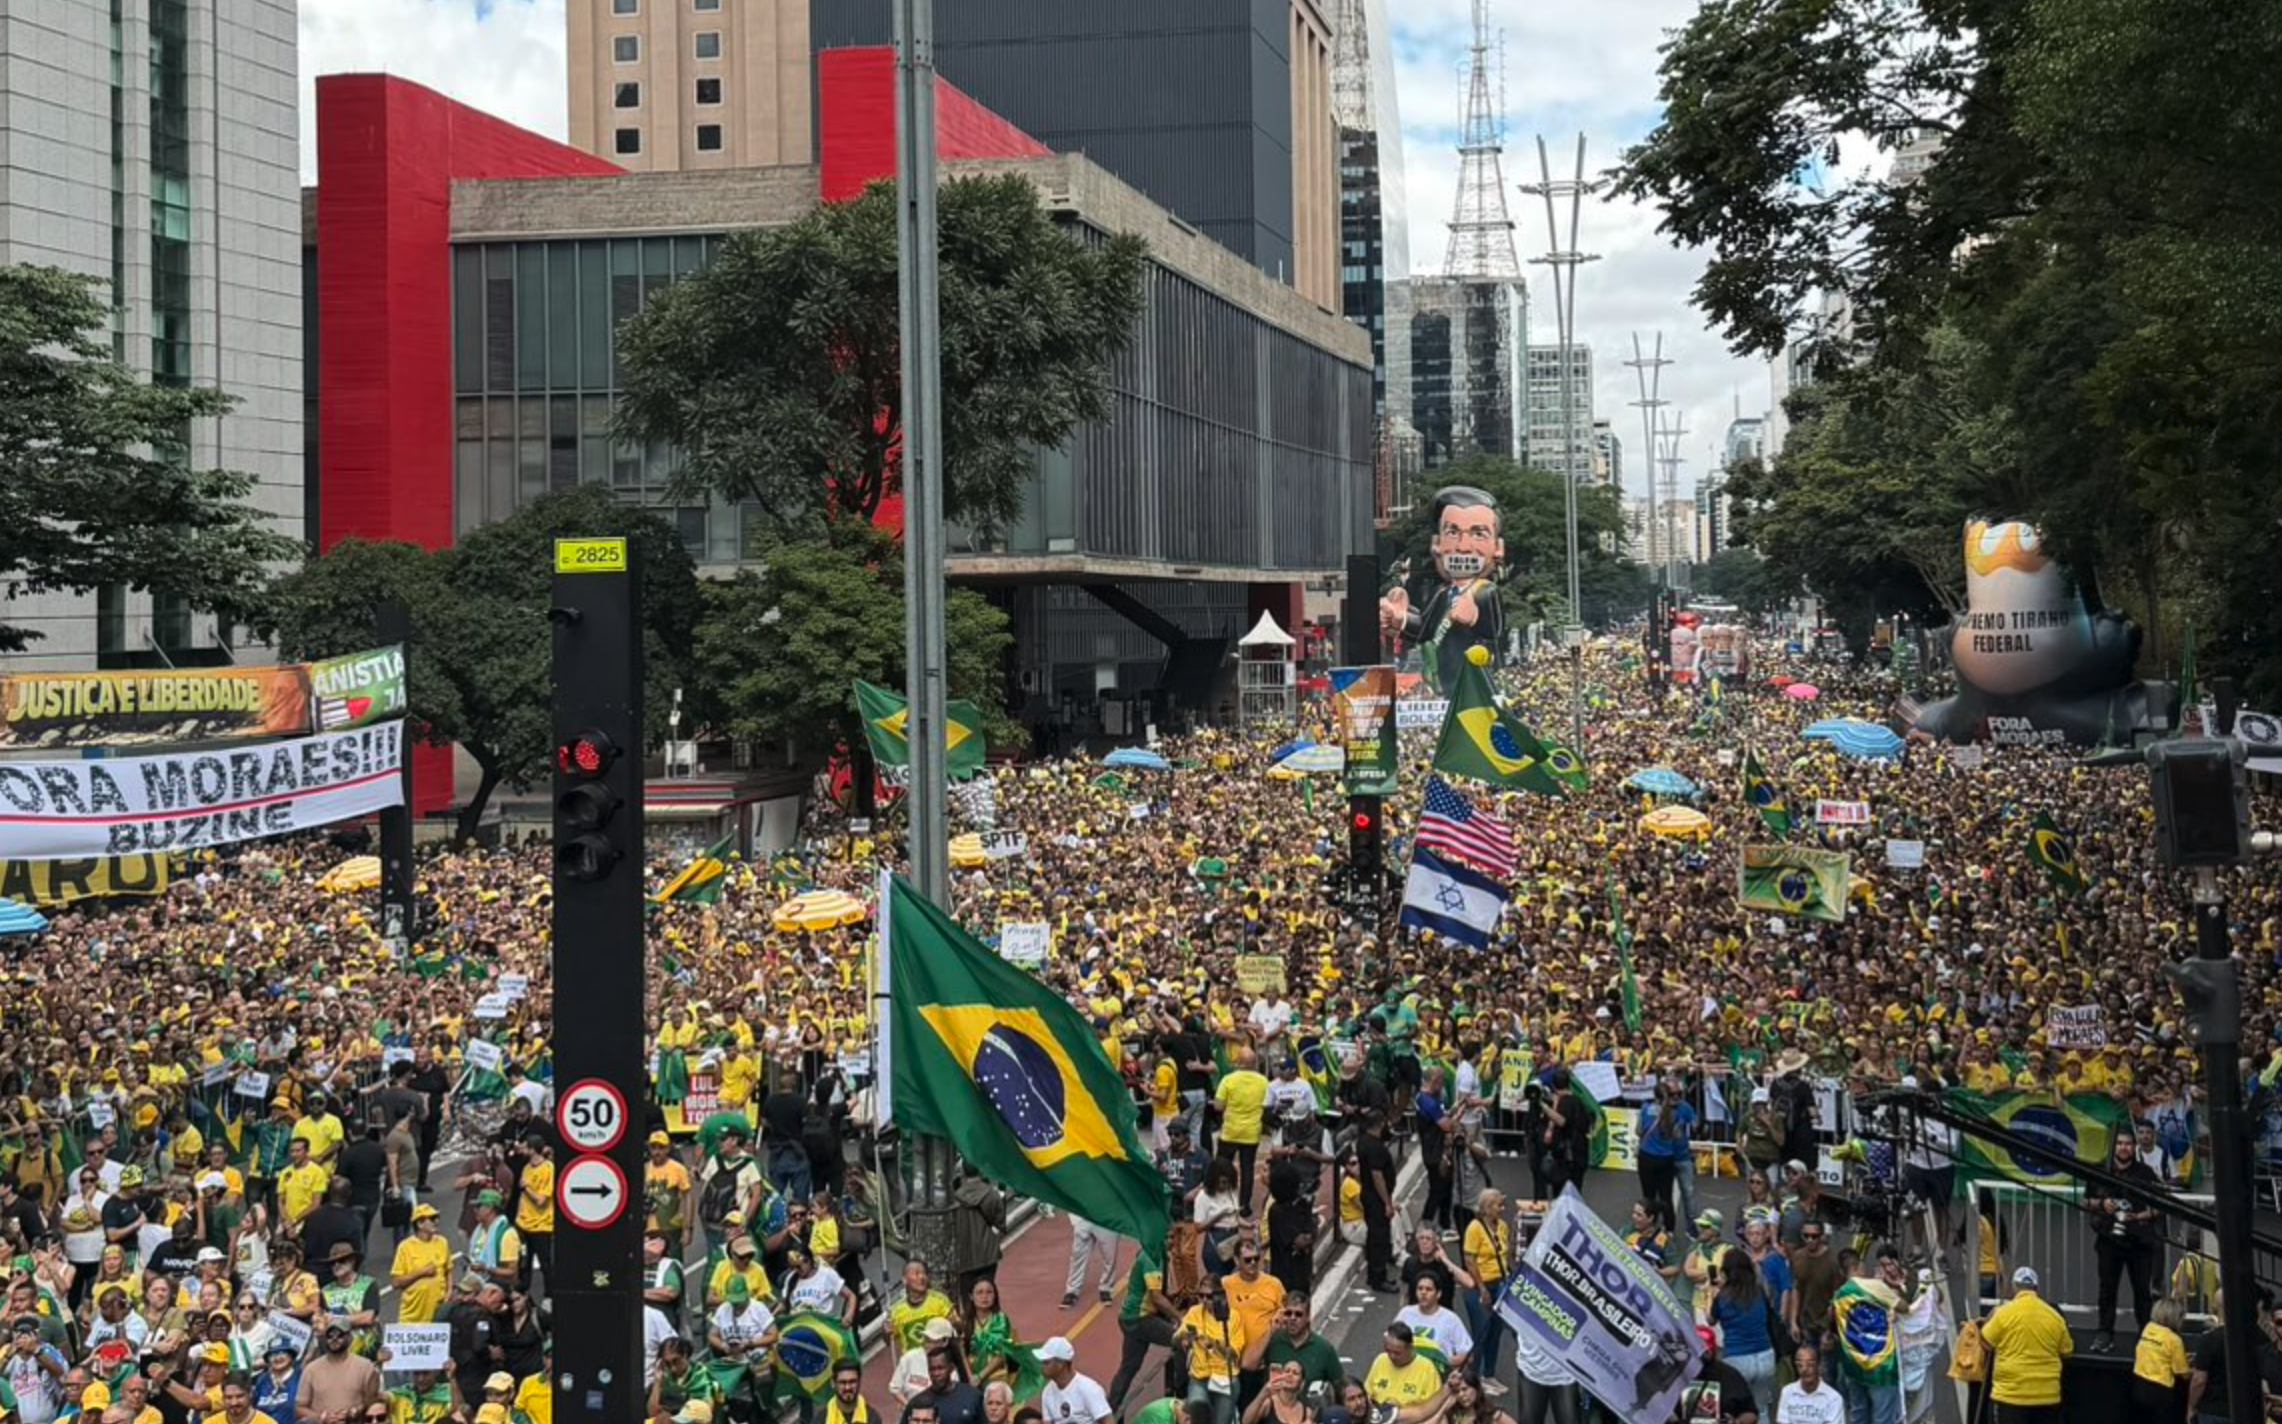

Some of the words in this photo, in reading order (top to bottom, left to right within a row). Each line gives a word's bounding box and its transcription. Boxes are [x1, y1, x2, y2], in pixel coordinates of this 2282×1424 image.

[575, 546, 620, 563] 2825
[2011, 610, 2070, 629] TIRANO
[1973, 634, 2034, 653] FEDERAL
[314, 651, 405, 697] ANISTIA
[138, 678, 261, 713] LIBERDADE
[1986, 716, 2034, 731] FORA
[1988, 729, 2066, 744] MORAES
[140, 724, 397, 812] MORAES!!!
[104, 800, 294, 854] BUZINE
[979, 830, 1023, 849] SPTF
[571, 1098, 613, 1128] 50
[1560, 1212, 1655, 1320] THOR
[1517, 1290, 1575, 1341] CAMPINAS
[1522, 1279, 1578, 1329] VINGADOR
[386, 1332, 448, 1344] BOLSONARO
[401, 1345, 431, 1356] LIVRE
